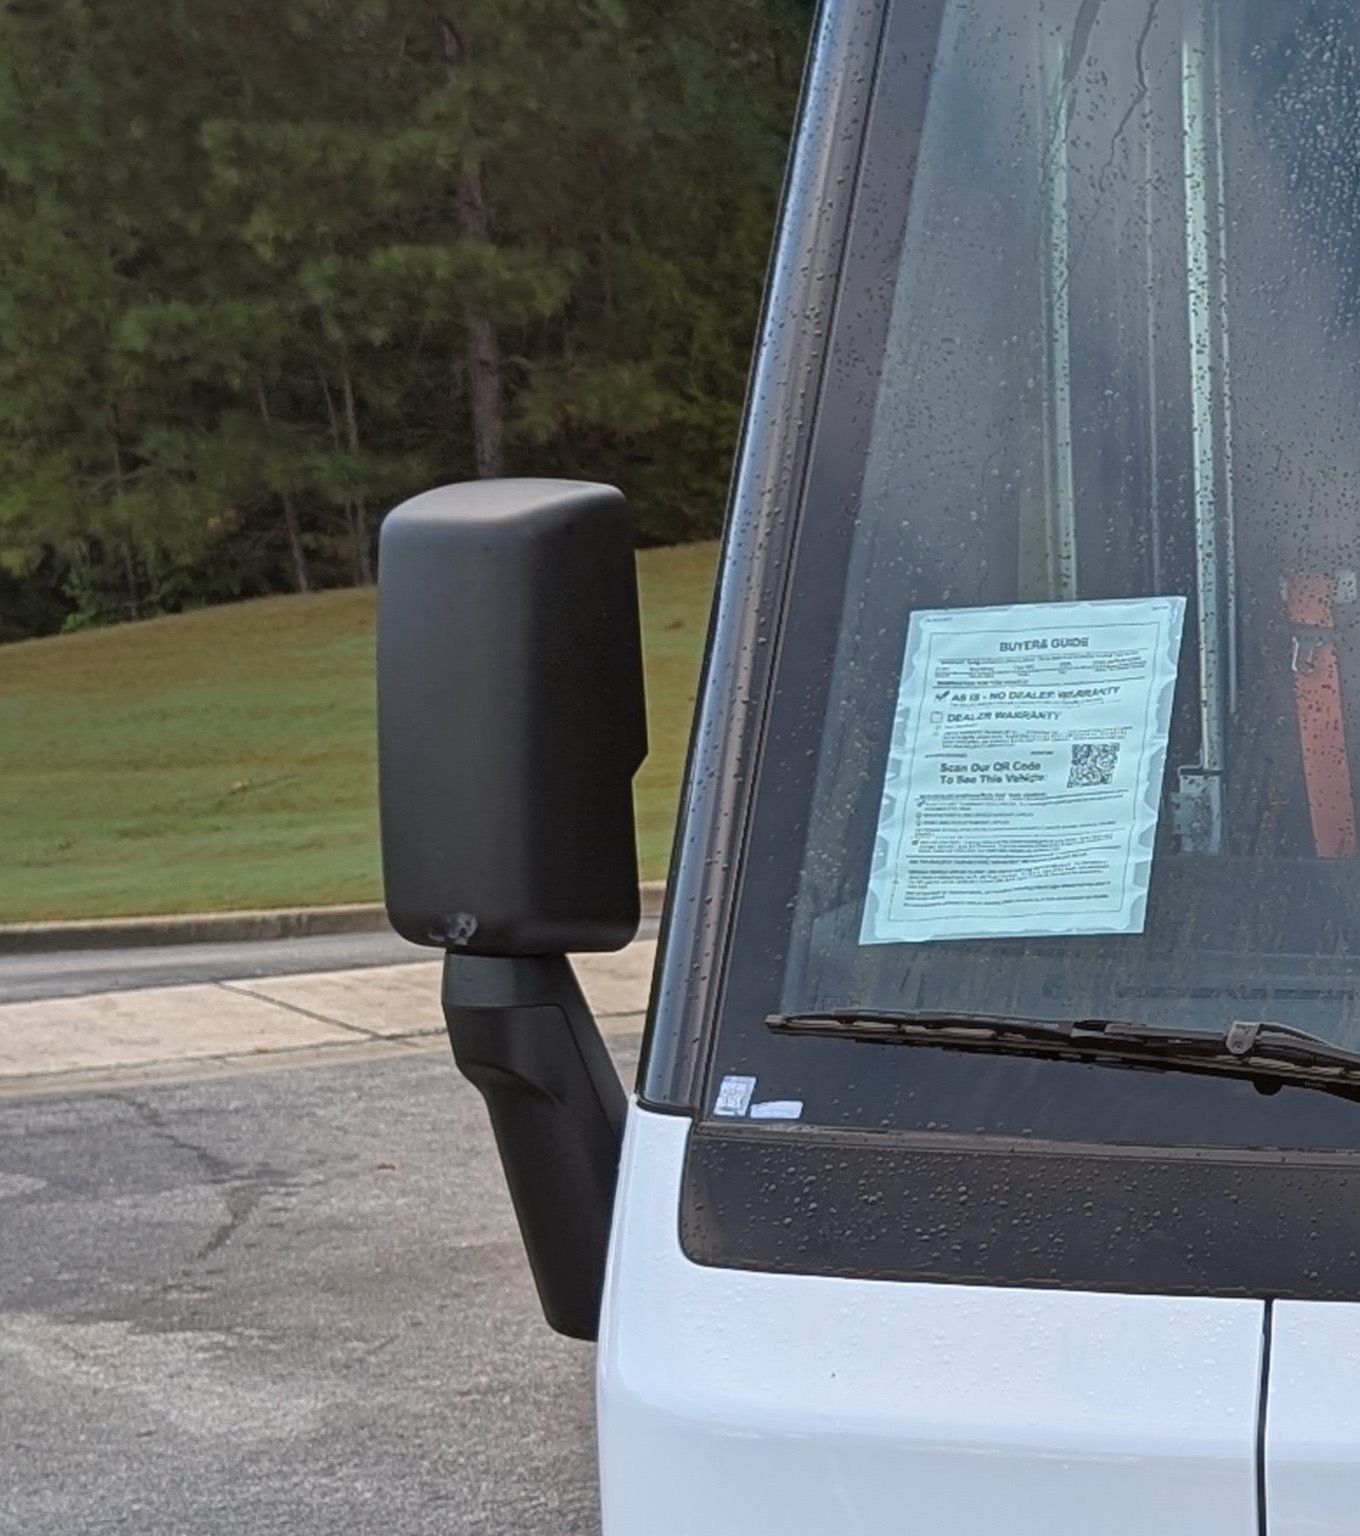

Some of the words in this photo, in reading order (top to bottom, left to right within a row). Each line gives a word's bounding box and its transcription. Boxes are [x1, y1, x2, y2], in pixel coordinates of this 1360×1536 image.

[1051, 637, 1089, 649] GUIDE
[989, 691, 1007, 700] NO
[1009, 690, 1056, 700] DEALER
[1058, 686, 1120, 700] WARRANTY
[947, 712, 992, 722] DEALER
[995, 711, 1061, 721] WARRANTY
[940, 763, 968, 773] Scan
[971, 763, 991, 773] Our
[993, 762, 1010, 773] QR
[1013, 761, 1041, 771] Code
[940, 775, 953, 784] To
[957, 775, 976, 784] See
[980, 774, 1003, 783] This
[1006, 773, 1045, 784] Vehicle
